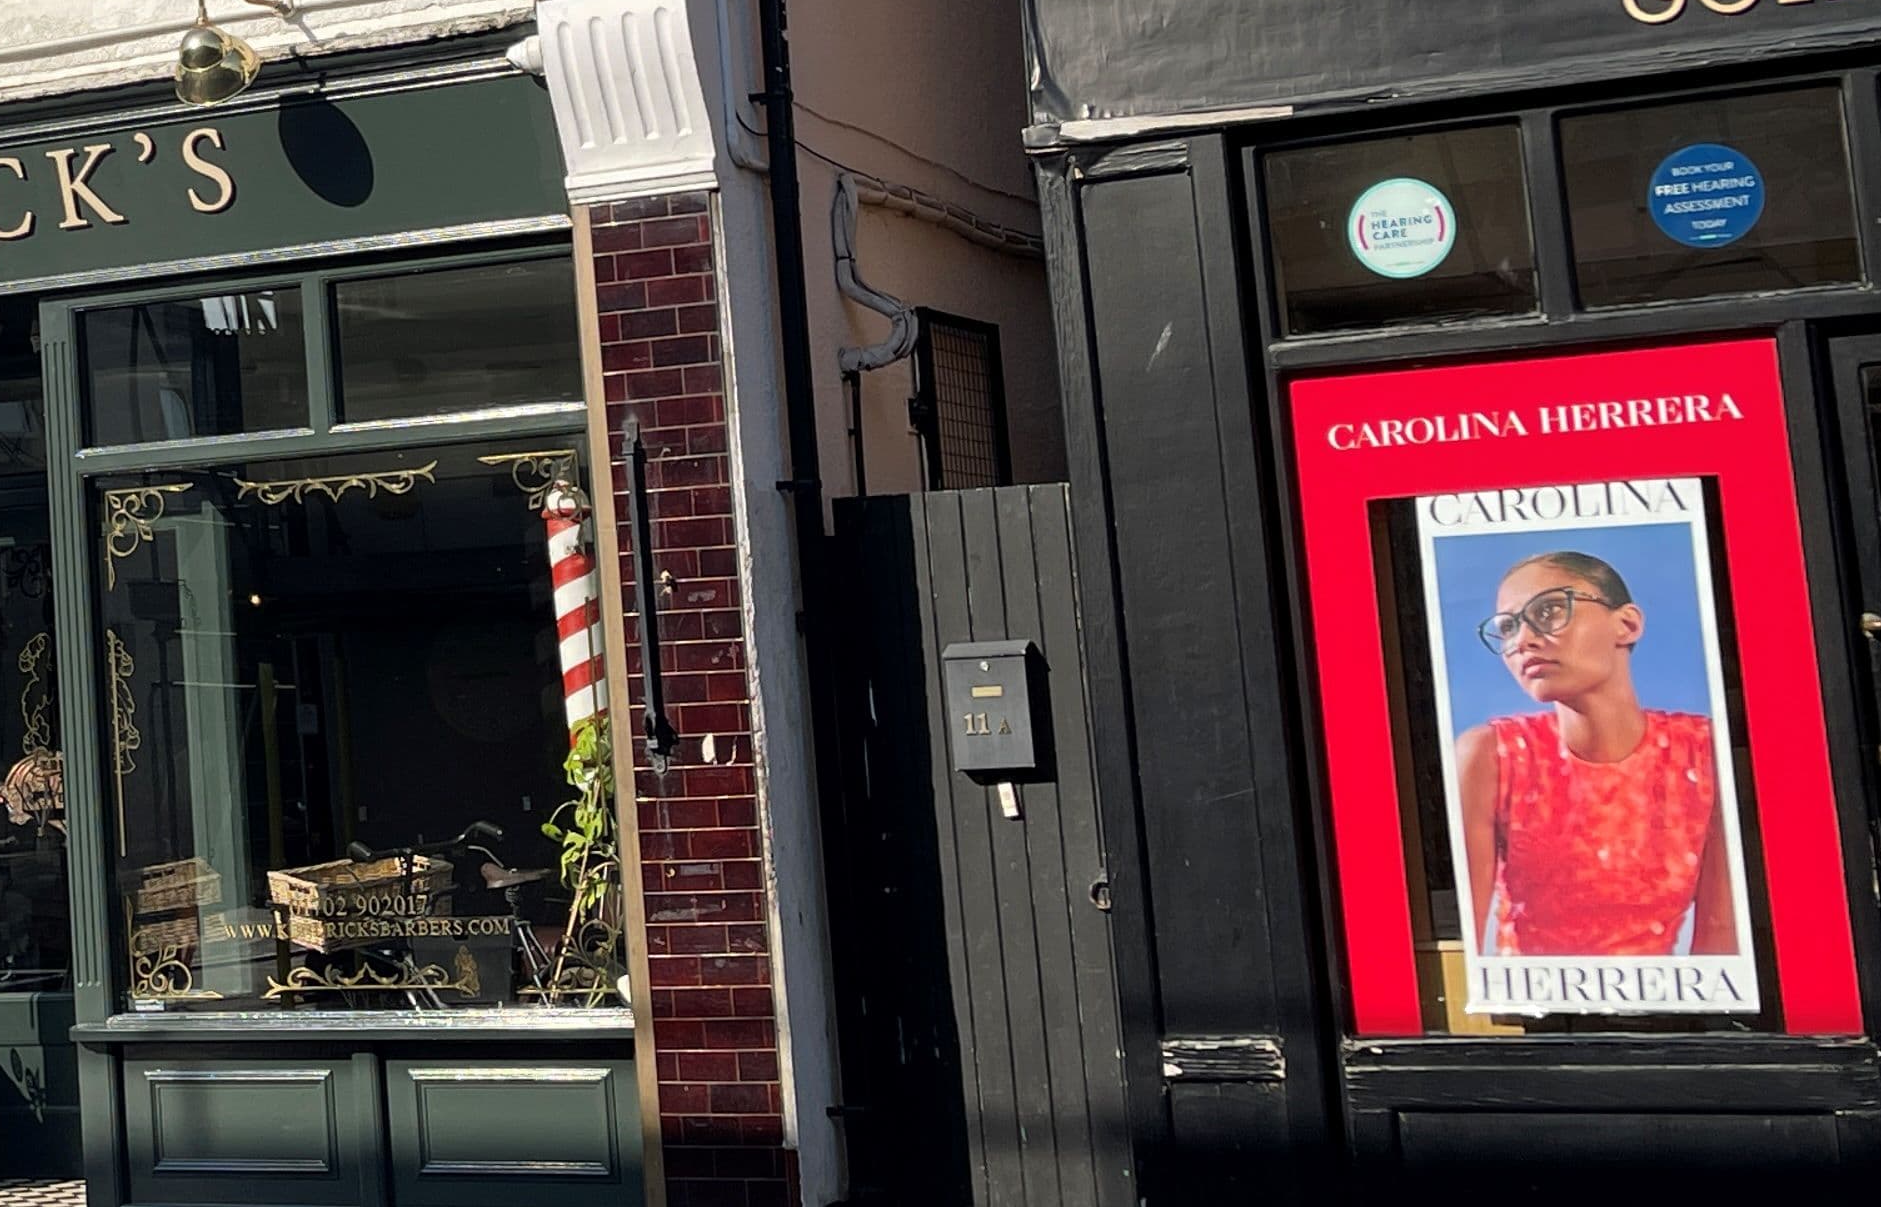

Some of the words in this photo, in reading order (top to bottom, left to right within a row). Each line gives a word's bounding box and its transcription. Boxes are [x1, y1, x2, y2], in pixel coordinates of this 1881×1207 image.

[1671, 166, 1700, 177] BOOK
[1703, 161, 1734, 173] YOUR
[1655, 183, 1689, 196] FREE
[1691, 176, 1755, 192] HEARING
[1664, 194, 1750, 214] ASSESSMENT
[1371, 215, 1433, 230] HEARING
[1372, 228, 1408, 241] CARE
[1328, 410, 1528, 451] CAROLINA
[1539, 393, 1744, 435] HERRERA
[1429, 478, 1688, 527] CAROLINA
[964, 712, 992, 736] 11
[998, 717, 1012, 735] A
[356, 894, 428, 916] 902017
[225, 918, 511, 940] WWW.KRICKSBARBERS.COM
[1481, 966, 1744, 1002] HERRERA
